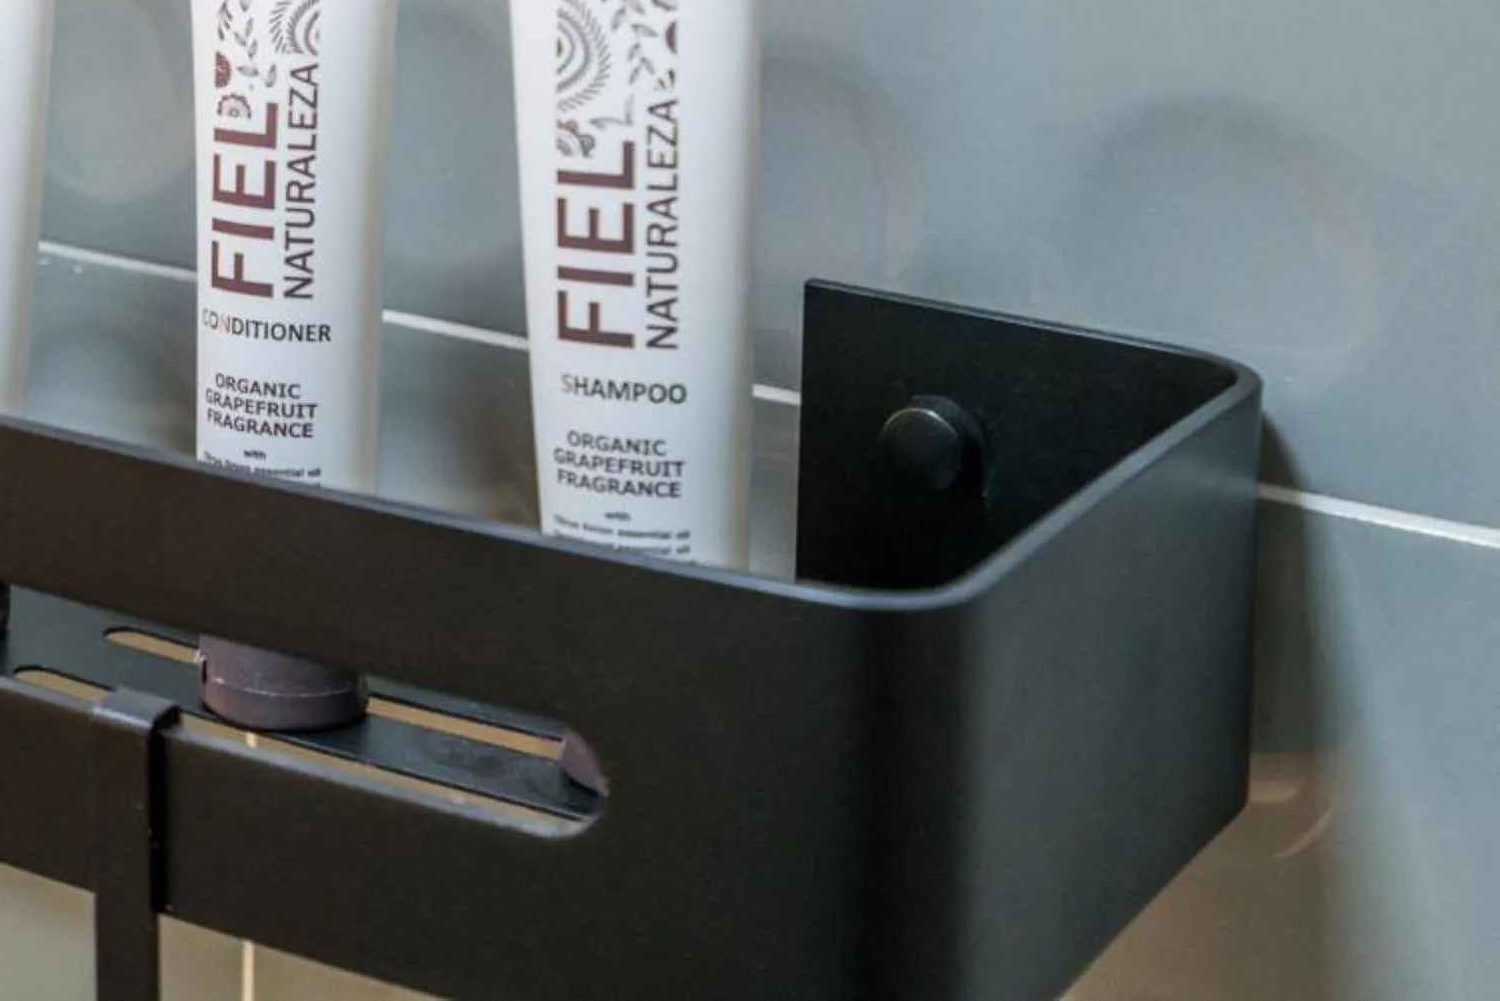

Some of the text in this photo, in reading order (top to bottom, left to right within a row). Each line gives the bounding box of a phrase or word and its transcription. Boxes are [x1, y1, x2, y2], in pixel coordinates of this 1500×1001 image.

[283, 63, 319, 299] NATURALEZA
[211, 102, 279, 299] FIEL
[646, 100, 679, 349] NATURALEZA
[557, 140, 635, 349] FIEL
[202, 308, 332, 343] CONDITIONER
[215, 372, 301, 399] ORGANIC
[561, 373, 688, 404] SHAMPOO
[205, 387, 318, 419] GRAPEFRUIT
[207, 407, 315, 438] FRAGRANCE
[567, 430, 667, 457] ORGANIC
[553, 447, 686, 477] GRAPEFRUIT
[557, 468, 682, 498] FRAGRANCE
